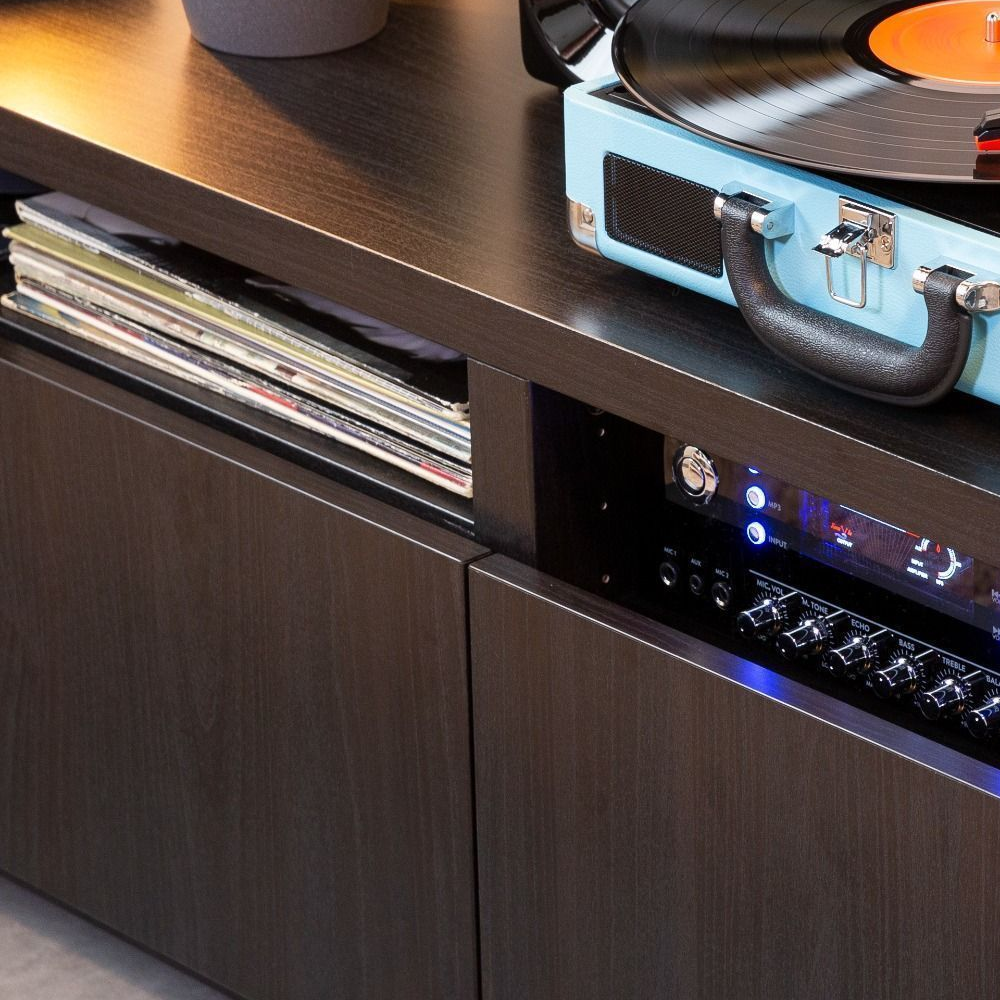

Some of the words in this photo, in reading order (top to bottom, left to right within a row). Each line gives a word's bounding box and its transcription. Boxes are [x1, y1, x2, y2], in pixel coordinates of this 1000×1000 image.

[768, 500, 782, 511] MP3
[769, 536, 788, 549] INPUT
[771, 585, 785, 597] VOL
[811, 601, 829, 615] TONE
[851, 618, 870, 632] ECHO
[898, 638, 915, 651] BASS
[942, 656, 966, 672] TREBLE
